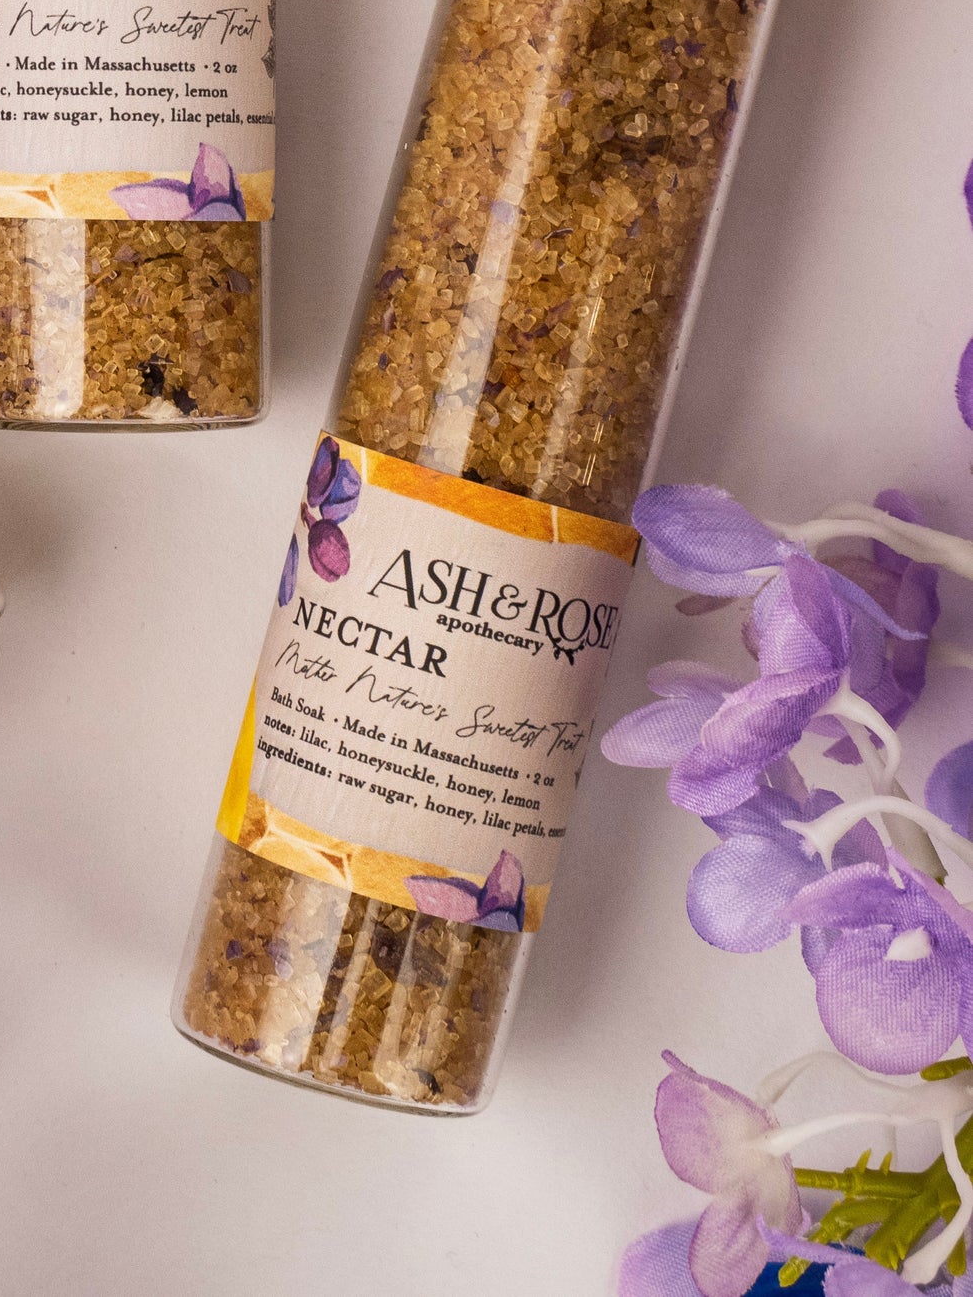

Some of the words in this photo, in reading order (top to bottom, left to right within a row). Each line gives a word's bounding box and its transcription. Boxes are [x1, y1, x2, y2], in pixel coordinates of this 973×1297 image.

[9, 2, 109, 36] Nature's
[120, 6, 216, 44] Sweetest
[216, 8, 260, 44] Treat
[15, 56, 56, 71] Made
[62, 58, 78, 71] in
[85, 56, 195, 72] Massachusetts
[213, 62, 221, 73] 2
[225, 64, 238, 73] oz
[17, 81, 118, 100] honeysuckle,
[125, 82, 179, 102] honey,
[185, 83, 228, 98] lemon
[23, 112, 49, 121] raw
[54, 112, 102, 126] sugar,
[110, 107, 165, 127] honey,
[171, 108, 201, 123] lilac
[206, 109, 244, 127] petals,
[293, 597, 449, 678] NECTAR
[437, 610, 544, 656] apothecary
[275, 639, 337, 682] Mother
[345, 666, 448, 721] Nature's
[456, 705, 549, 749] Sweetest
[551, 722, 584, 757] Treat
[264, 715, 296, 737] notes:
[299, 726, 331, 752] lilac,
[337, 741, 439, 787] honeysuckle,
[445, 774, 496, 803] honey,
[501, 789, 541, 810] lemon
[271, 686, 293, 709] Bath
[296, 698, 325, 722] Soak
[342, 716, 386, 742] Made
[390, 732, 408, 750] in
[413, 738, 519, 779] Massachusetts
[533, 773, 540, 785] 2
[543, 776, 556, 787] oz
[257, 736, 332, 778] ingredients:
[338, 772, 366, 789] raw
[369, 782, 418, 808] sugar,
[424, 795, 477, 825] honey,
[482, 811, 511, 831] lilac
[512, 821, 545, 838] petals,
